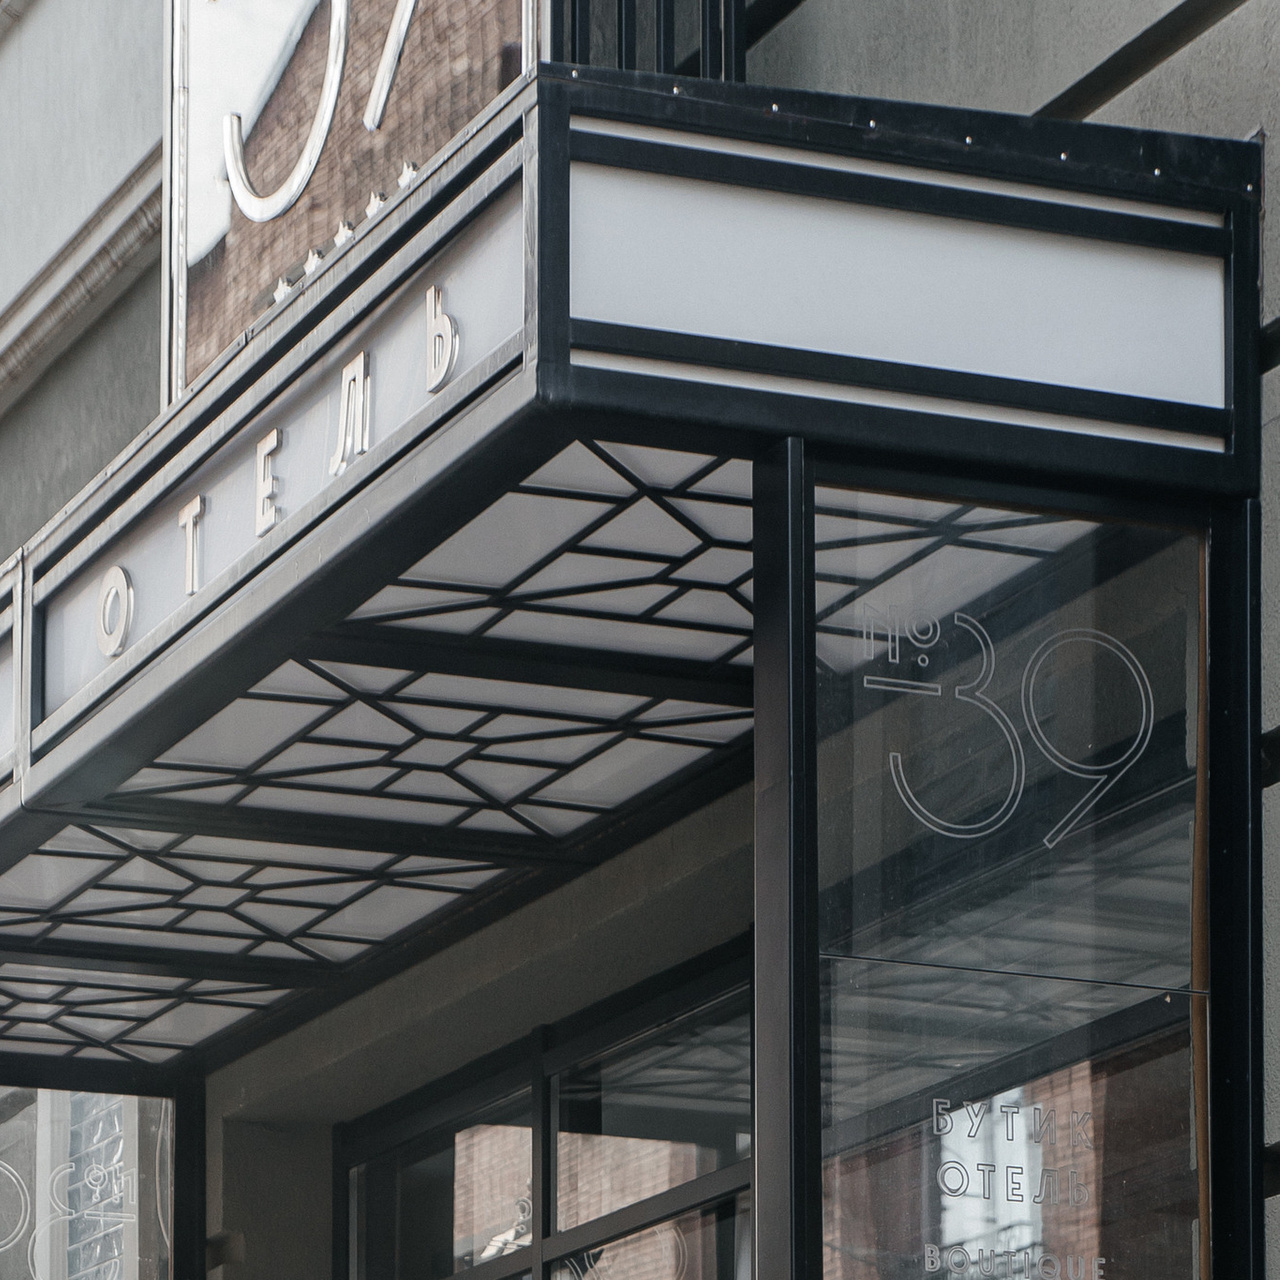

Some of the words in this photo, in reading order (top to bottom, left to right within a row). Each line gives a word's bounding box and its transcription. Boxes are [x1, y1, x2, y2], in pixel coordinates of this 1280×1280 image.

[97, 285, 461, 657] ОТЕЛЬ
[932, 1098, 1094, 1149] БУТИК
[935, 1160, 1090, 1207] ОТЕЛЬ
